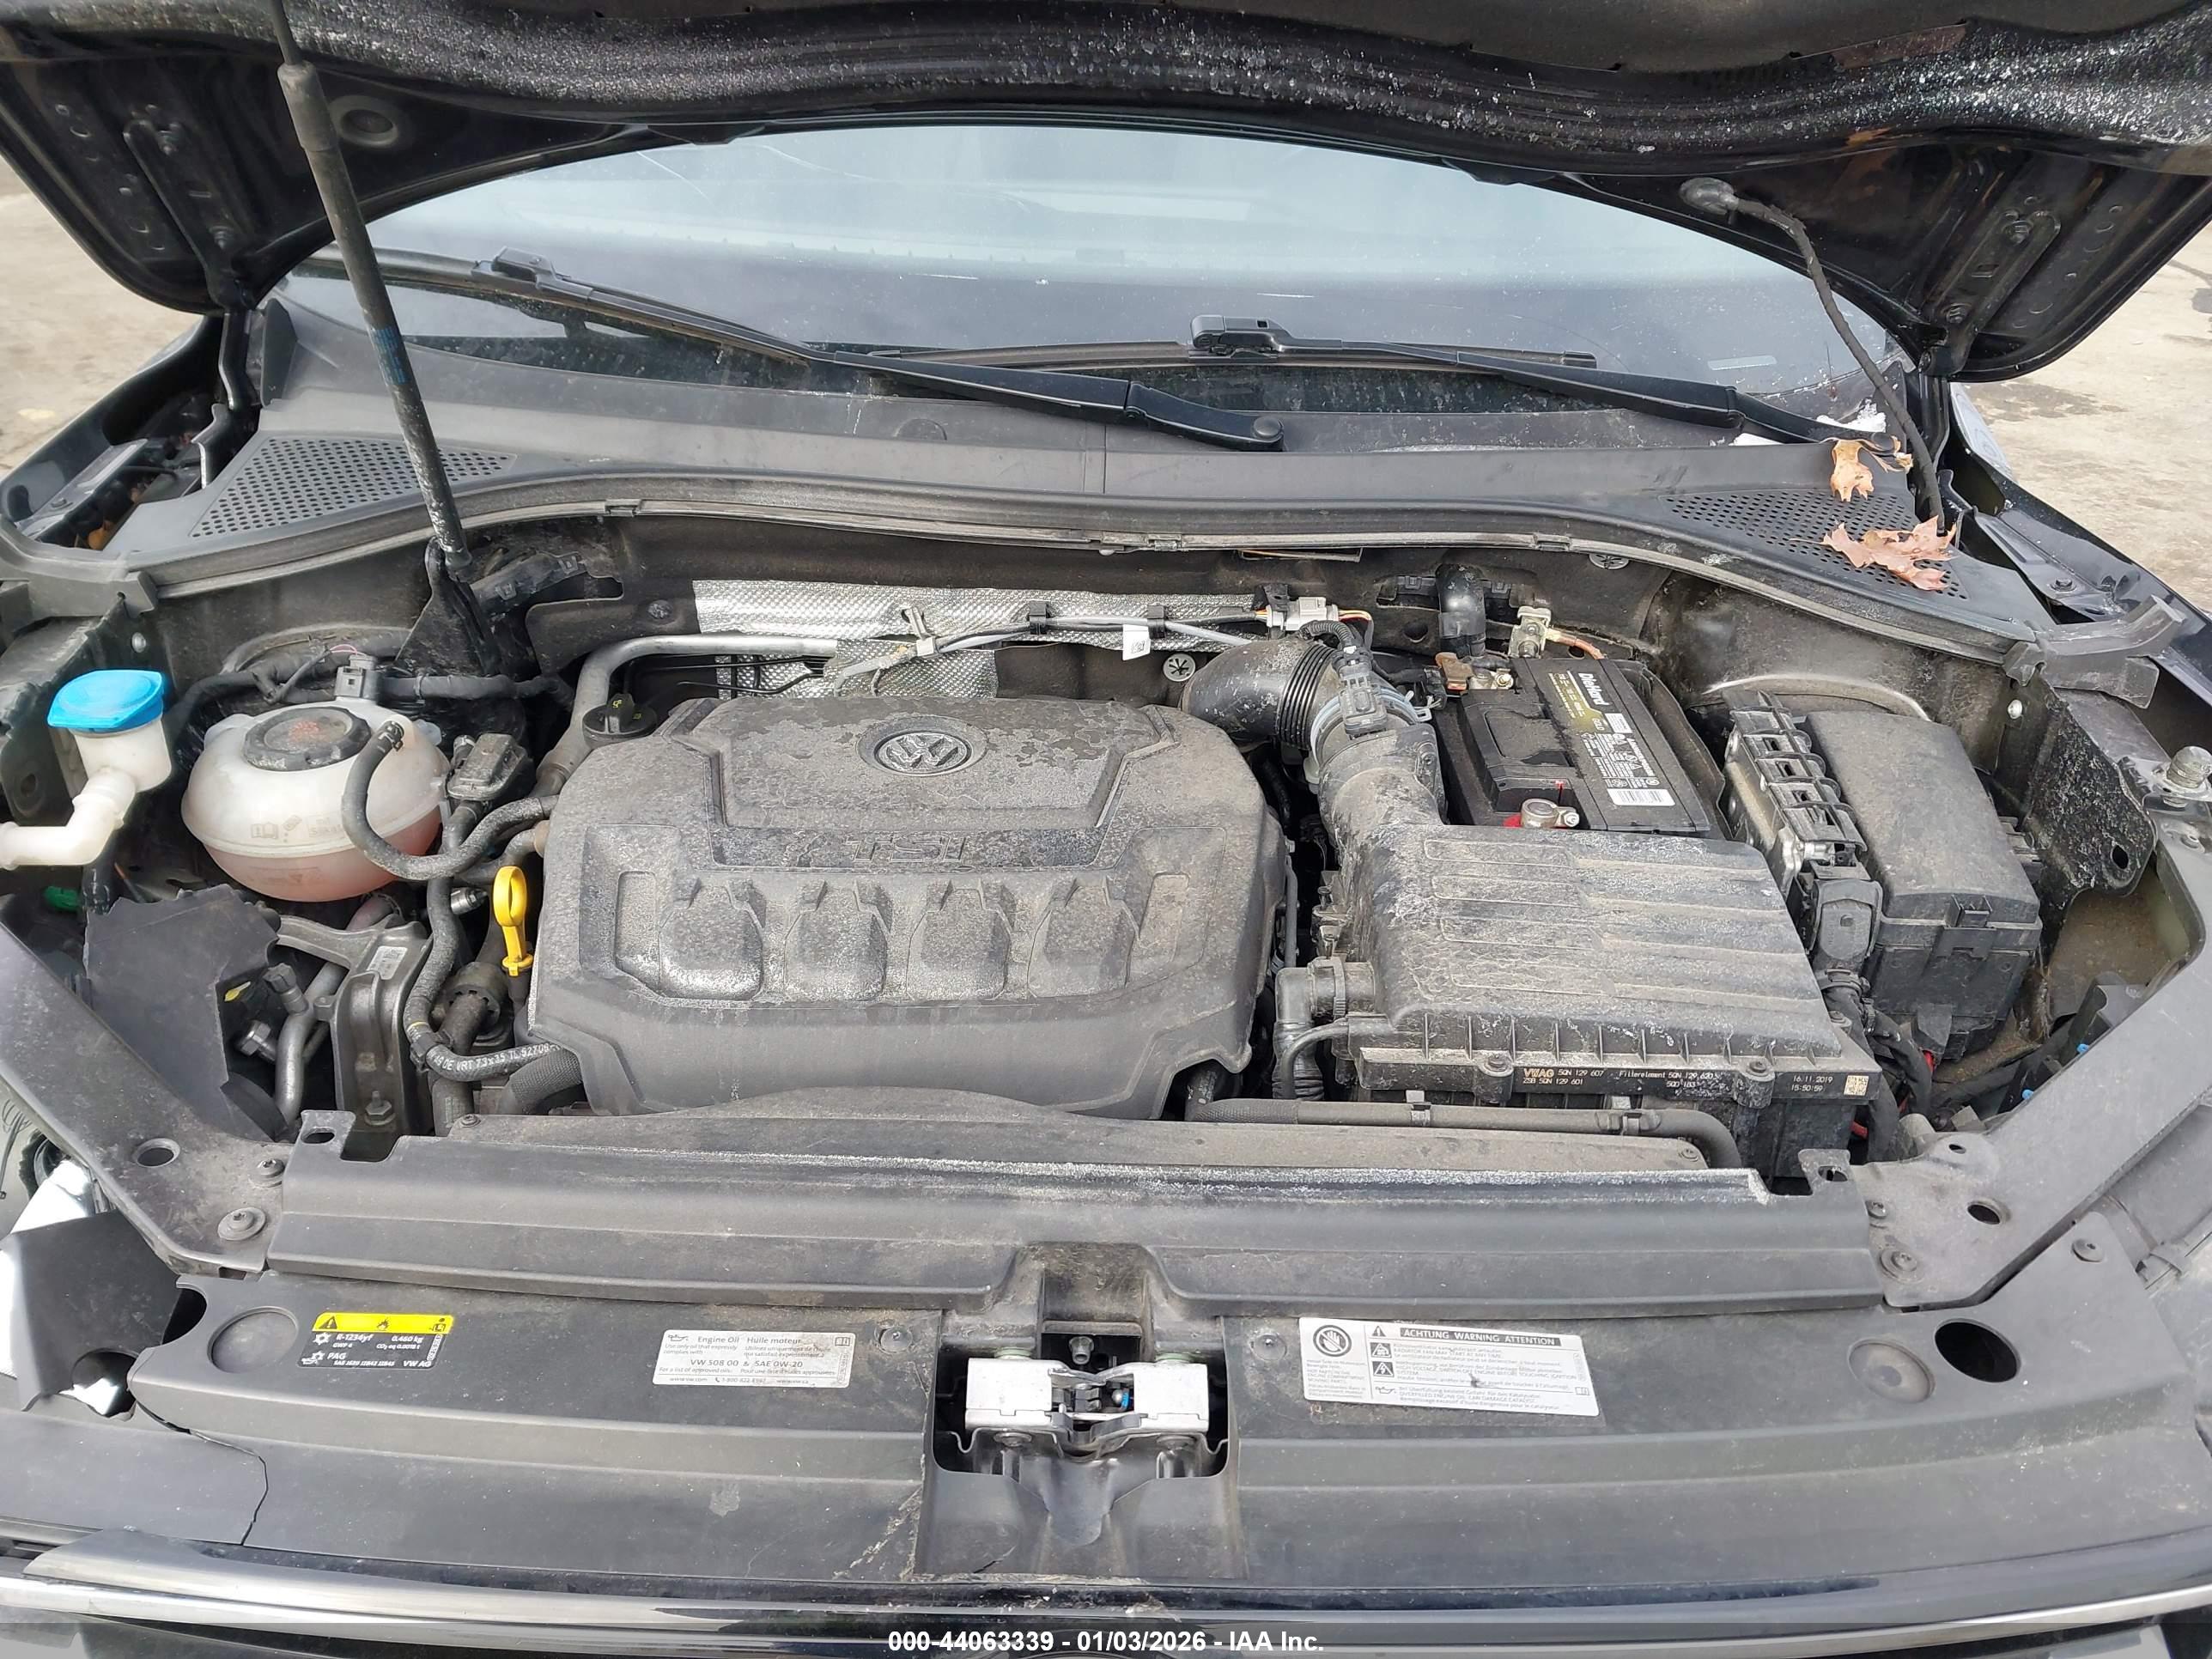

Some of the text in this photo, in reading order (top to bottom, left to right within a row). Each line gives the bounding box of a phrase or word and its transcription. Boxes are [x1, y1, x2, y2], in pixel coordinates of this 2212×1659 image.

[1577, 672, 1609, 705] DieHard
[846, 832, 966, 863] TSI
[1523, 1068, 1554, 1078] VWAG
[1793, 1075, 1833, 1084] 16.11.2019
[336, 1334, 374, 1342] R-1234yf
[696, 1336, 726, 1345] Engine
[1403, 1329, 1556, 1346] ACHTUNG WARNING ATTENTION
